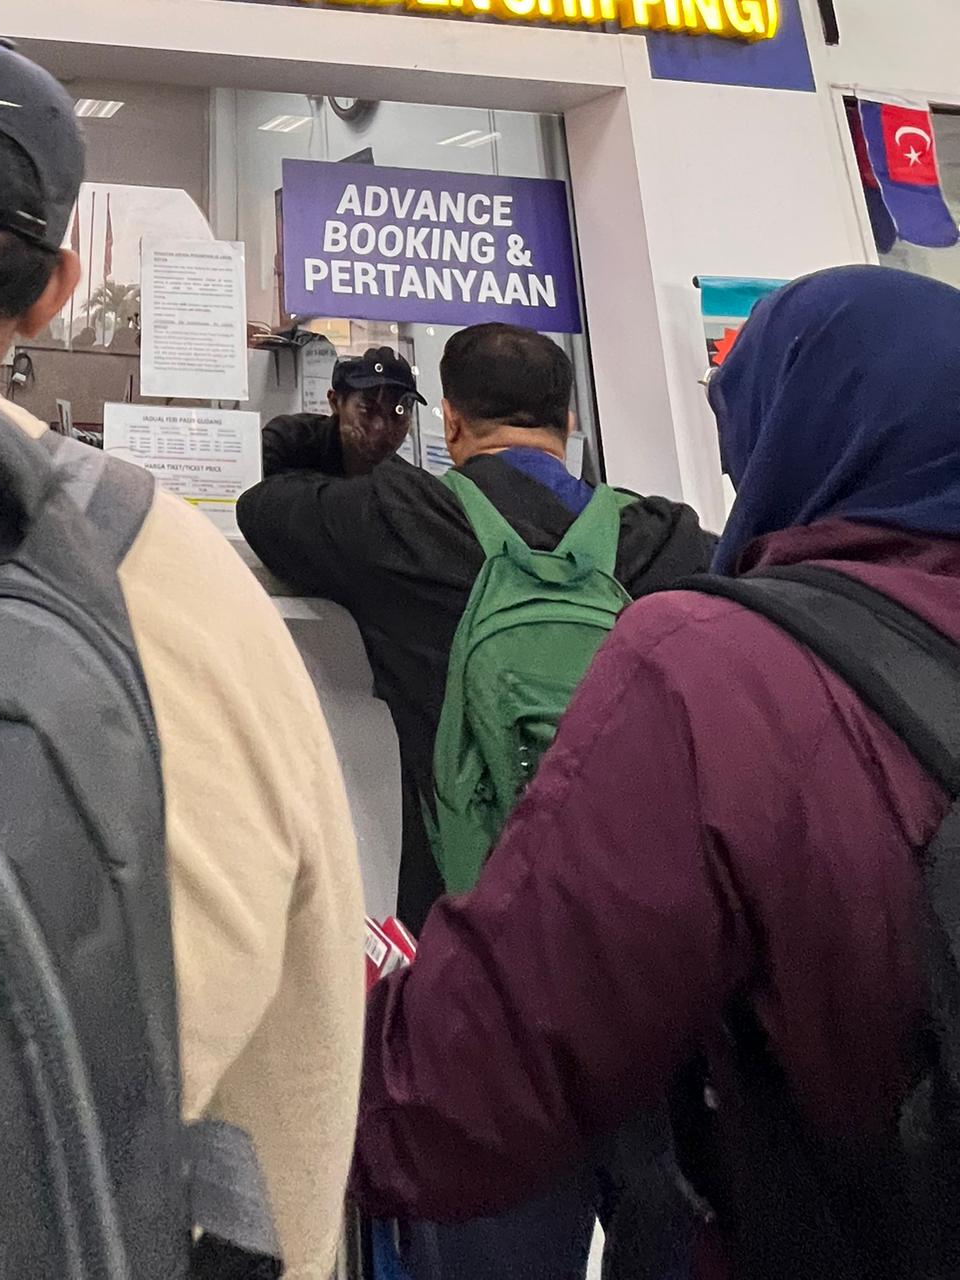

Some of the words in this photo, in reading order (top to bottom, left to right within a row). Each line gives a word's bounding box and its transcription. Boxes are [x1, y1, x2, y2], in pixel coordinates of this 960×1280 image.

[336, 184, 513, 227] ADVANCE
[323, 220, 495, 264] BOOKING
[506, 234, 533, 267] &
[304, 258, 556, 307] PERTANYAAN
